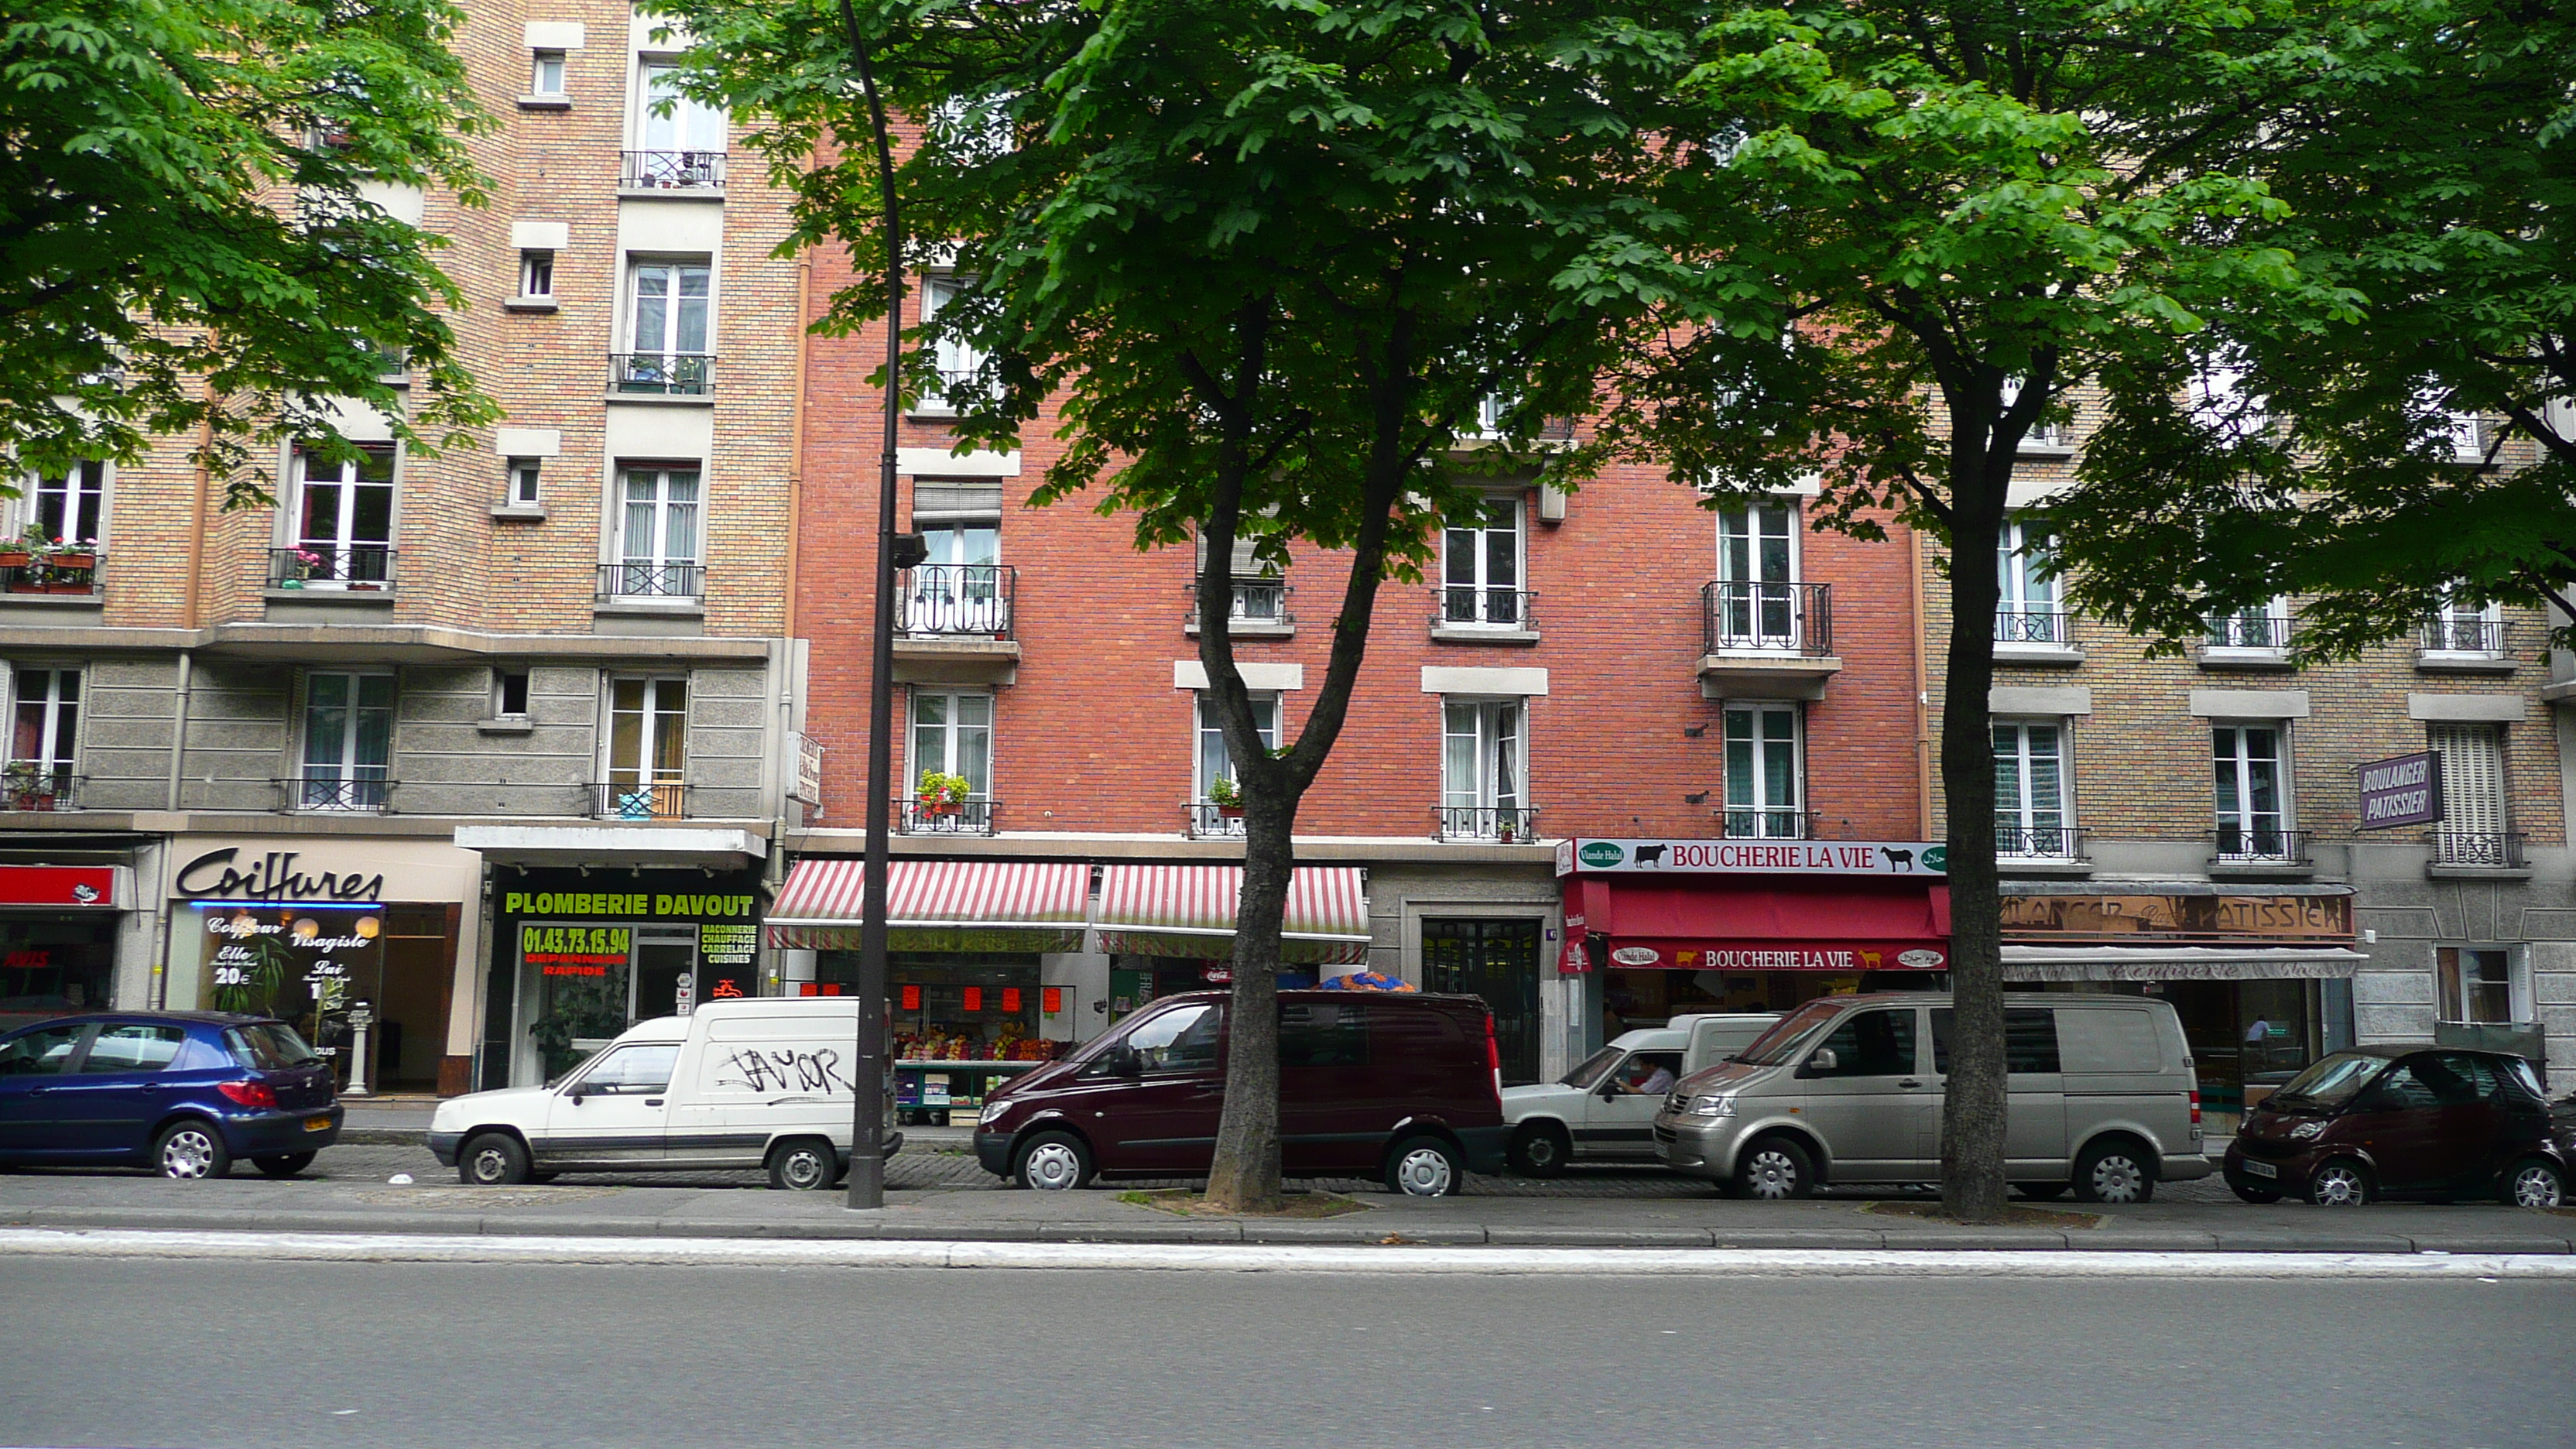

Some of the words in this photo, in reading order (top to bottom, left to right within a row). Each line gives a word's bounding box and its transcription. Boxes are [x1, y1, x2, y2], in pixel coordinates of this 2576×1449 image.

[2362, 760, 2427, 793] BOULANGER
[2366, 790, 2427, 820] PATISSIER
[1581, 849, 1604, 860] Viande
[1605, 849, 1623, 860] Halal
[1672, 845, 1800, 868] BOUCHERIE
[1807, 847, 1834, 868] LA
[1838, 848, 1875, 868] VIE
[176, 847, 384, 901] Coiffures
[505, 892, 648, 915] PLOMBERIE
[656, 894, 754, 916] DAVOUT
[701, 924, 757, 933] MACONNERIE
[289, 931, 372, 953] Visagiste
[523, 927, 629, 954] 01.43.73.15.94
[701, 934, 756, 944] CHAUFFAGE
[218, 946, 257, 960] Elle
[701, 944, 756, 954] CARRELAGE
[1639, 951, 1656, 961] Halal
[525, 954, 627, 964] DEPANNAGE
[708, 954, 751, 964] CUISINES
[1705, 951, 1800, 968] BOUCHERIE
[1804, 951, 1825, 968] LA
[1826, 951, 1854, 968] VIE
[214, 968, 251, 985] 20€
[543, 966, 606, 977] RAPIDE
[312, 1046, 336, 1056] OUS
